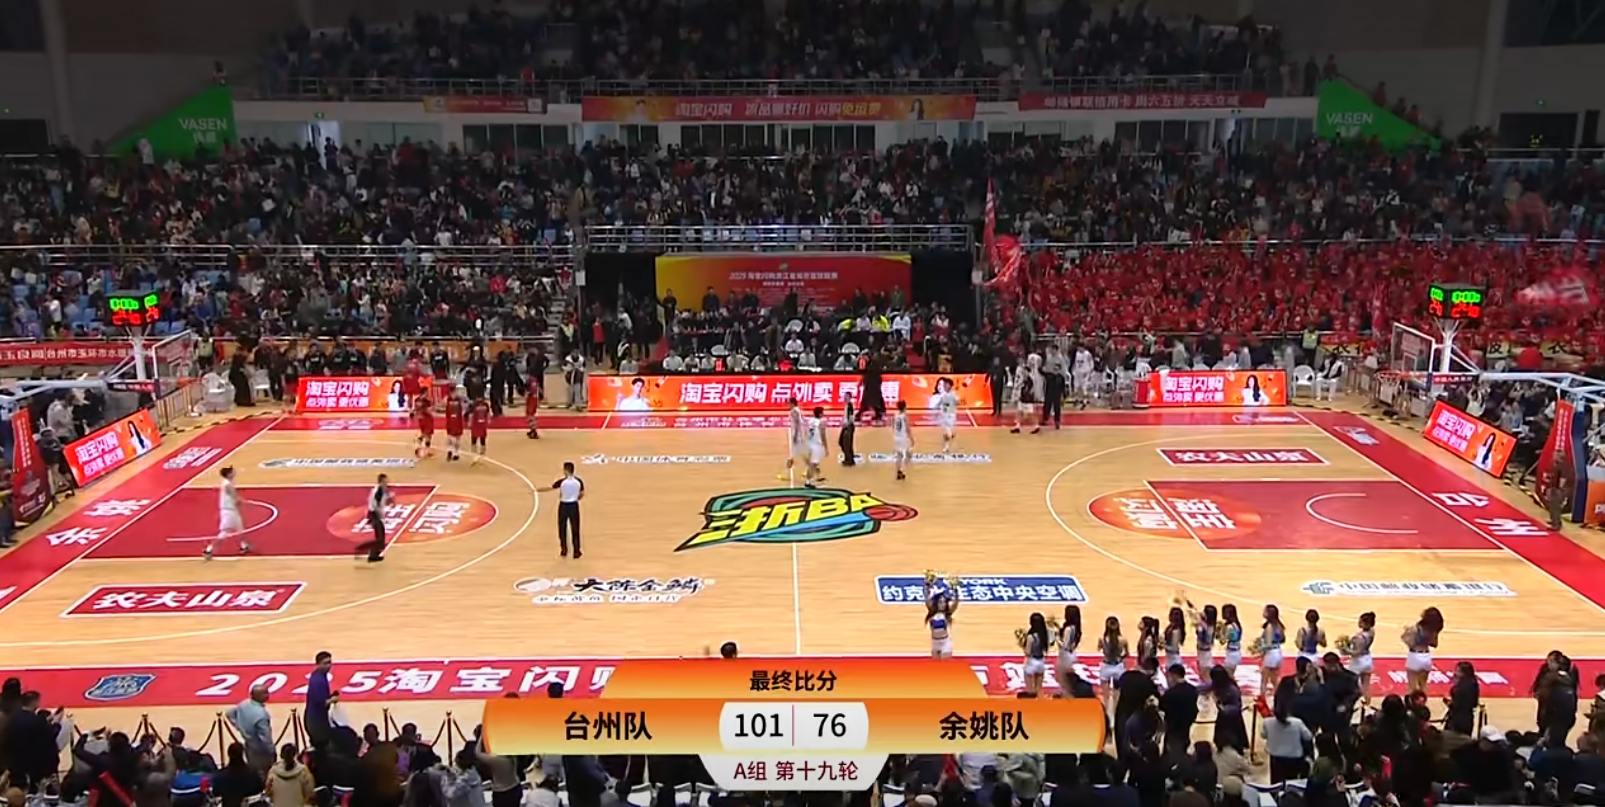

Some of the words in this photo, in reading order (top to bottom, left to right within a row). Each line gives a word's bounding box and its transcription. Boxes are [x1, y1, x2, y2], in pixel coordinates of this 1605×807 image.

[179, 118, 227, 130] VASEN
[1326, 112, 1373, 125] VASEN
[306, 381, 369, 396] 淘宝闪购
[680, 382, 767, 404] 淘宝闪购
[771, 381, 833, 403] 点外卖
[1174, 451, 1309, 463] 农夫山泉
[93, 589, 277, 610] 农夫山泉
